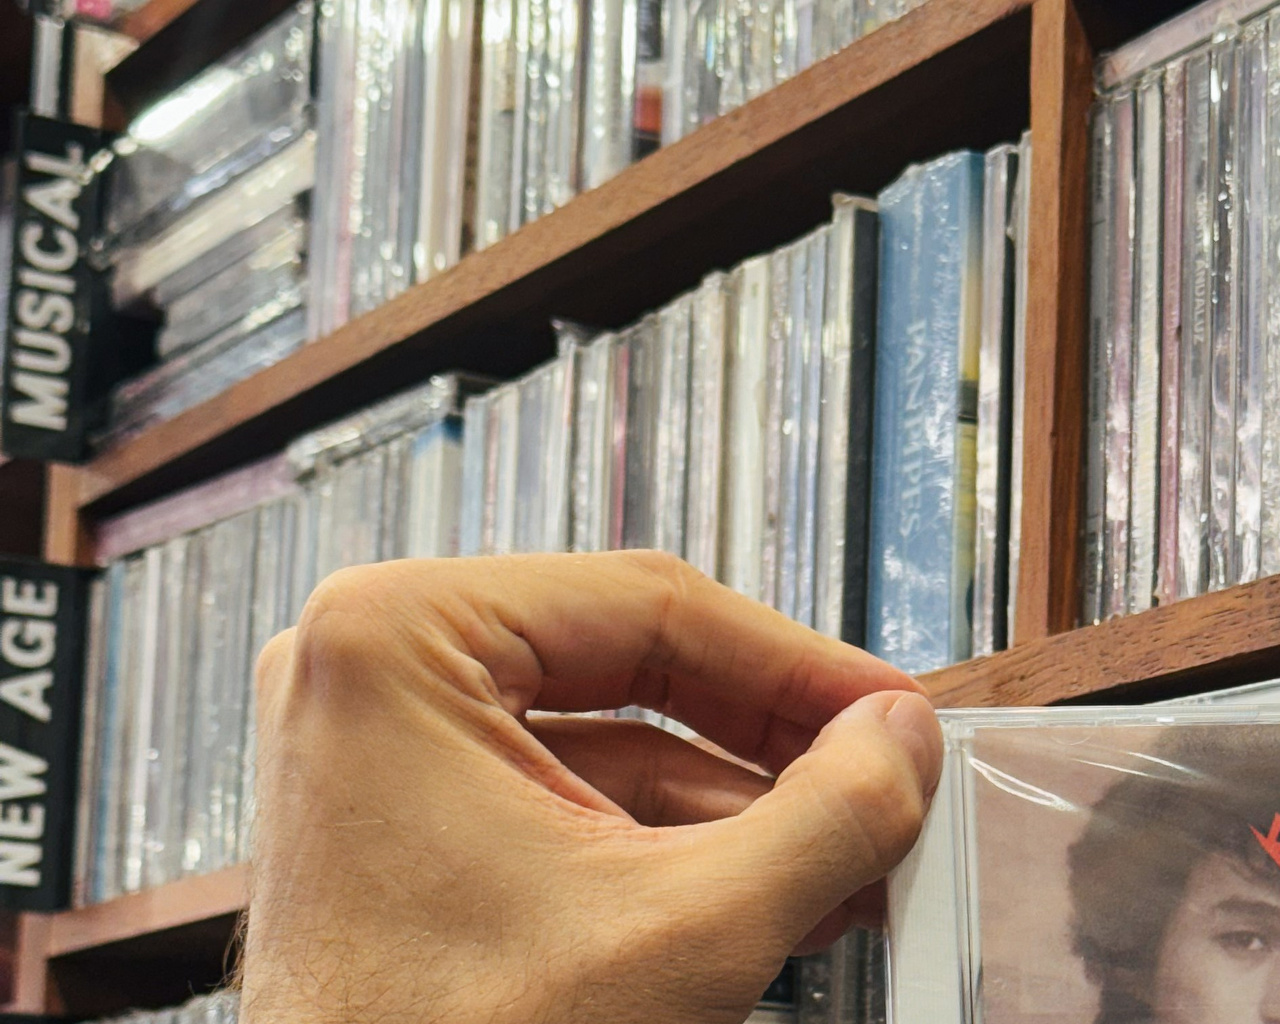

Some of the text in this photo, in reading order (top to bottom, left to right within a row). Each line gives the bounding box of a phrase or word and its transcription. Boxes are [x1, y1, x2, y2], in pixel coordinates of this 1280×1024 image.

[10, 140, 84, 432] MUSICAL
[0, 575, 59, 887] NEW AGE
